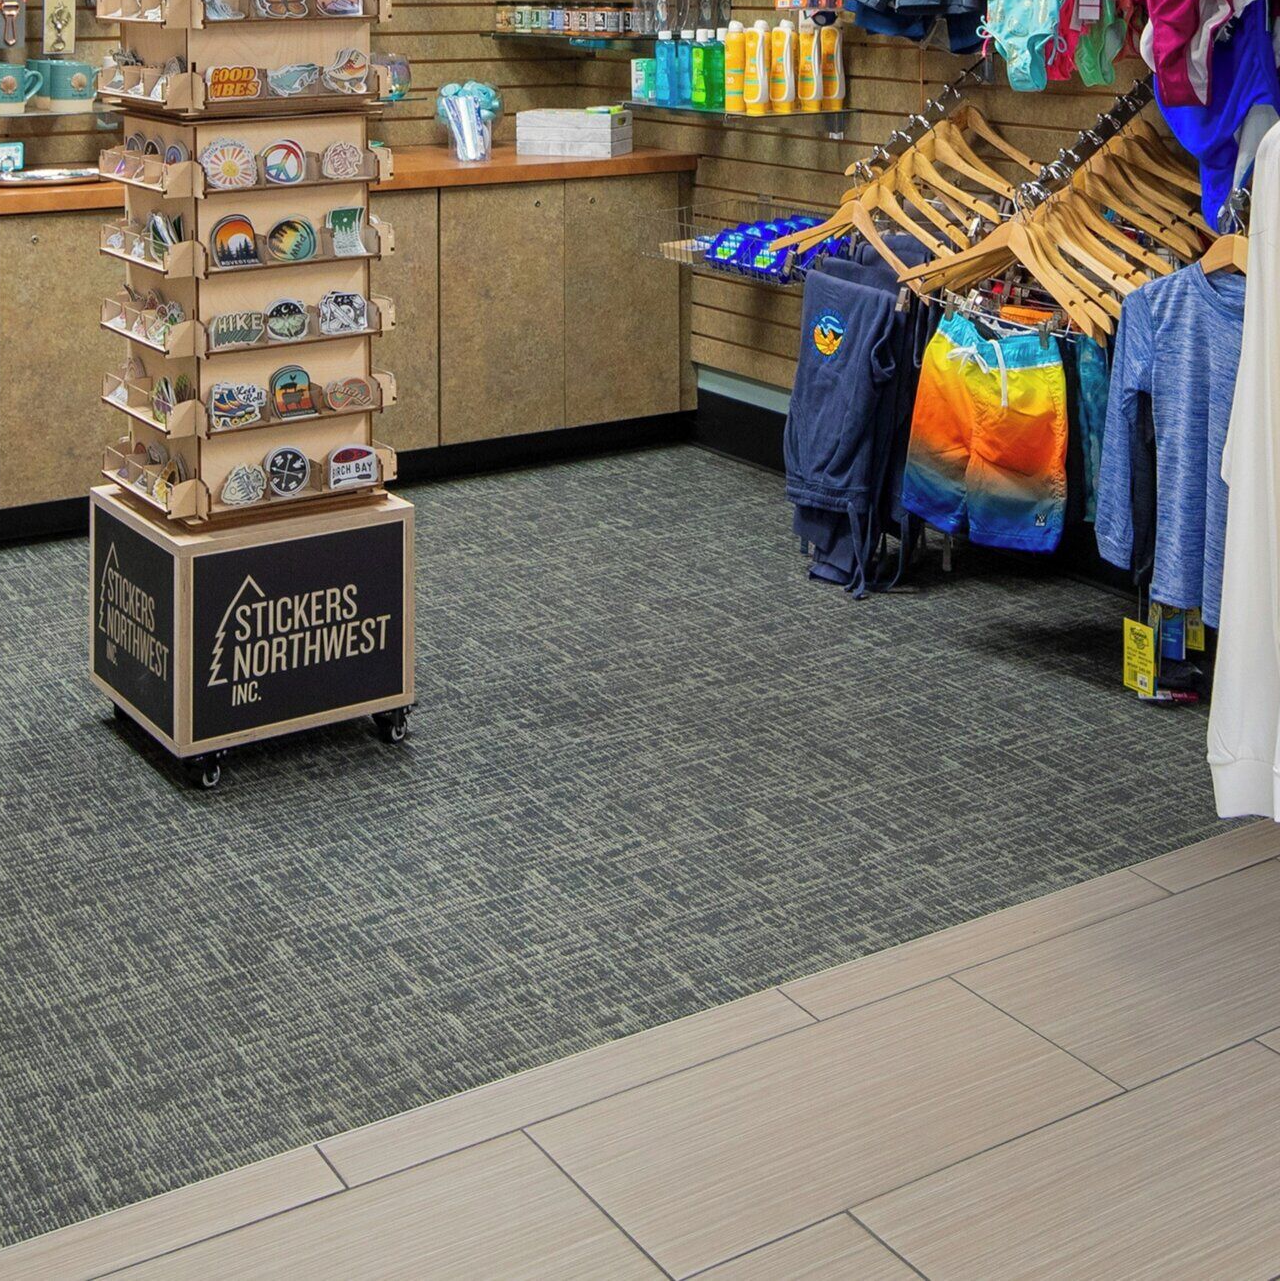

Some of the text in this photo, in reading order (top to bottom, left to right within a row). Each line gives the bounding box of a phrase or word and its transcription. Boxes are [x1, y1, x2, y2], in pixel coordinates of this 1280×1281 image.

[212, 66, 256, 82] GOOD
[210, 81, 259, 97] VIBES
[217, 312, 263, 334] HIKE
[235, 385, 256, 395] Let's
[243, 392, 263, 404] Roll
[332, 461, 373, 479] BIRCH BAY
[107, 567, 155, 633] STICKERS
[235, 584, 358, 642] STICKERS
[106, 602, 170, 681] NORTHWEST
[232, 614, 391, 682] NORTHWEST
[106, 642, 119, 667] INC.
[231, 681, 262, 707] INC.
